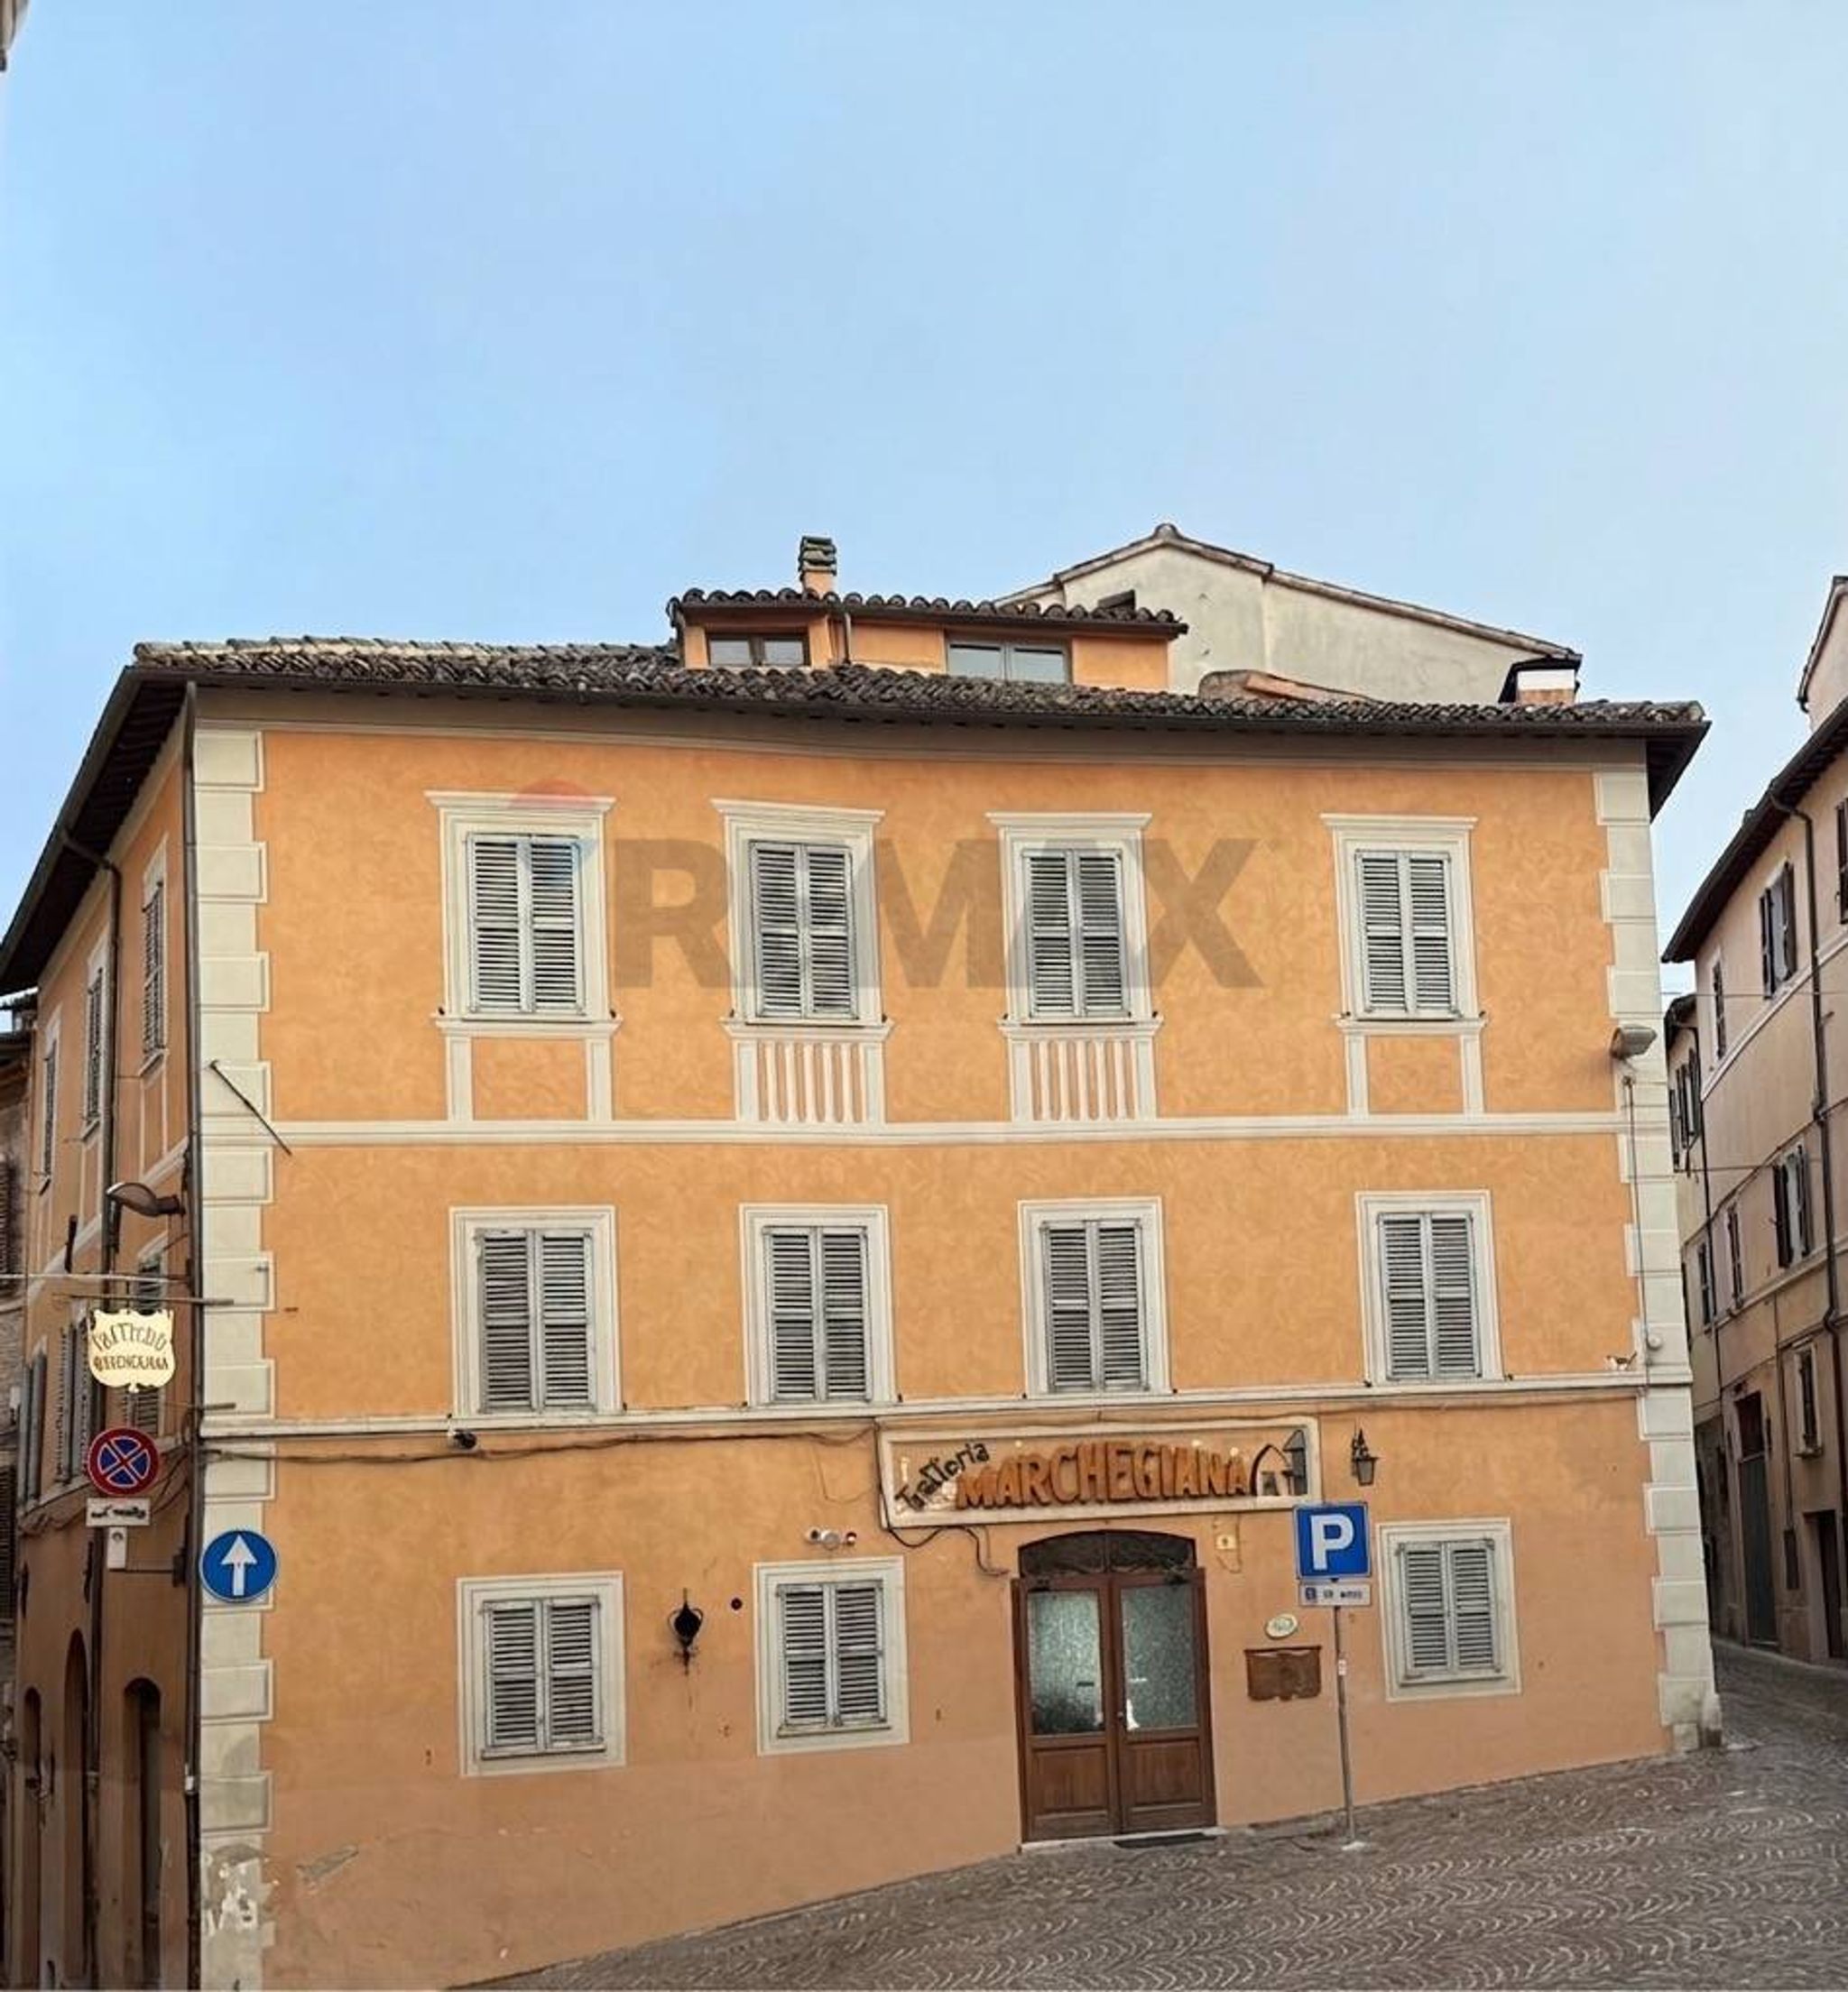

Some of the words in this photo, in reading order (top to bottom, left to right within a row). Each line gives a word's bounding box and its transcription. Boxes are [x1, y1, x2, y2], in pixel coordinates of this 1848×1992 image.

[894, 1442, 990, 1511] Trattoria
[956, 1441, 1250, 1510] MARCHEGIANA
[1310, 1513, 1354, 1571] P
